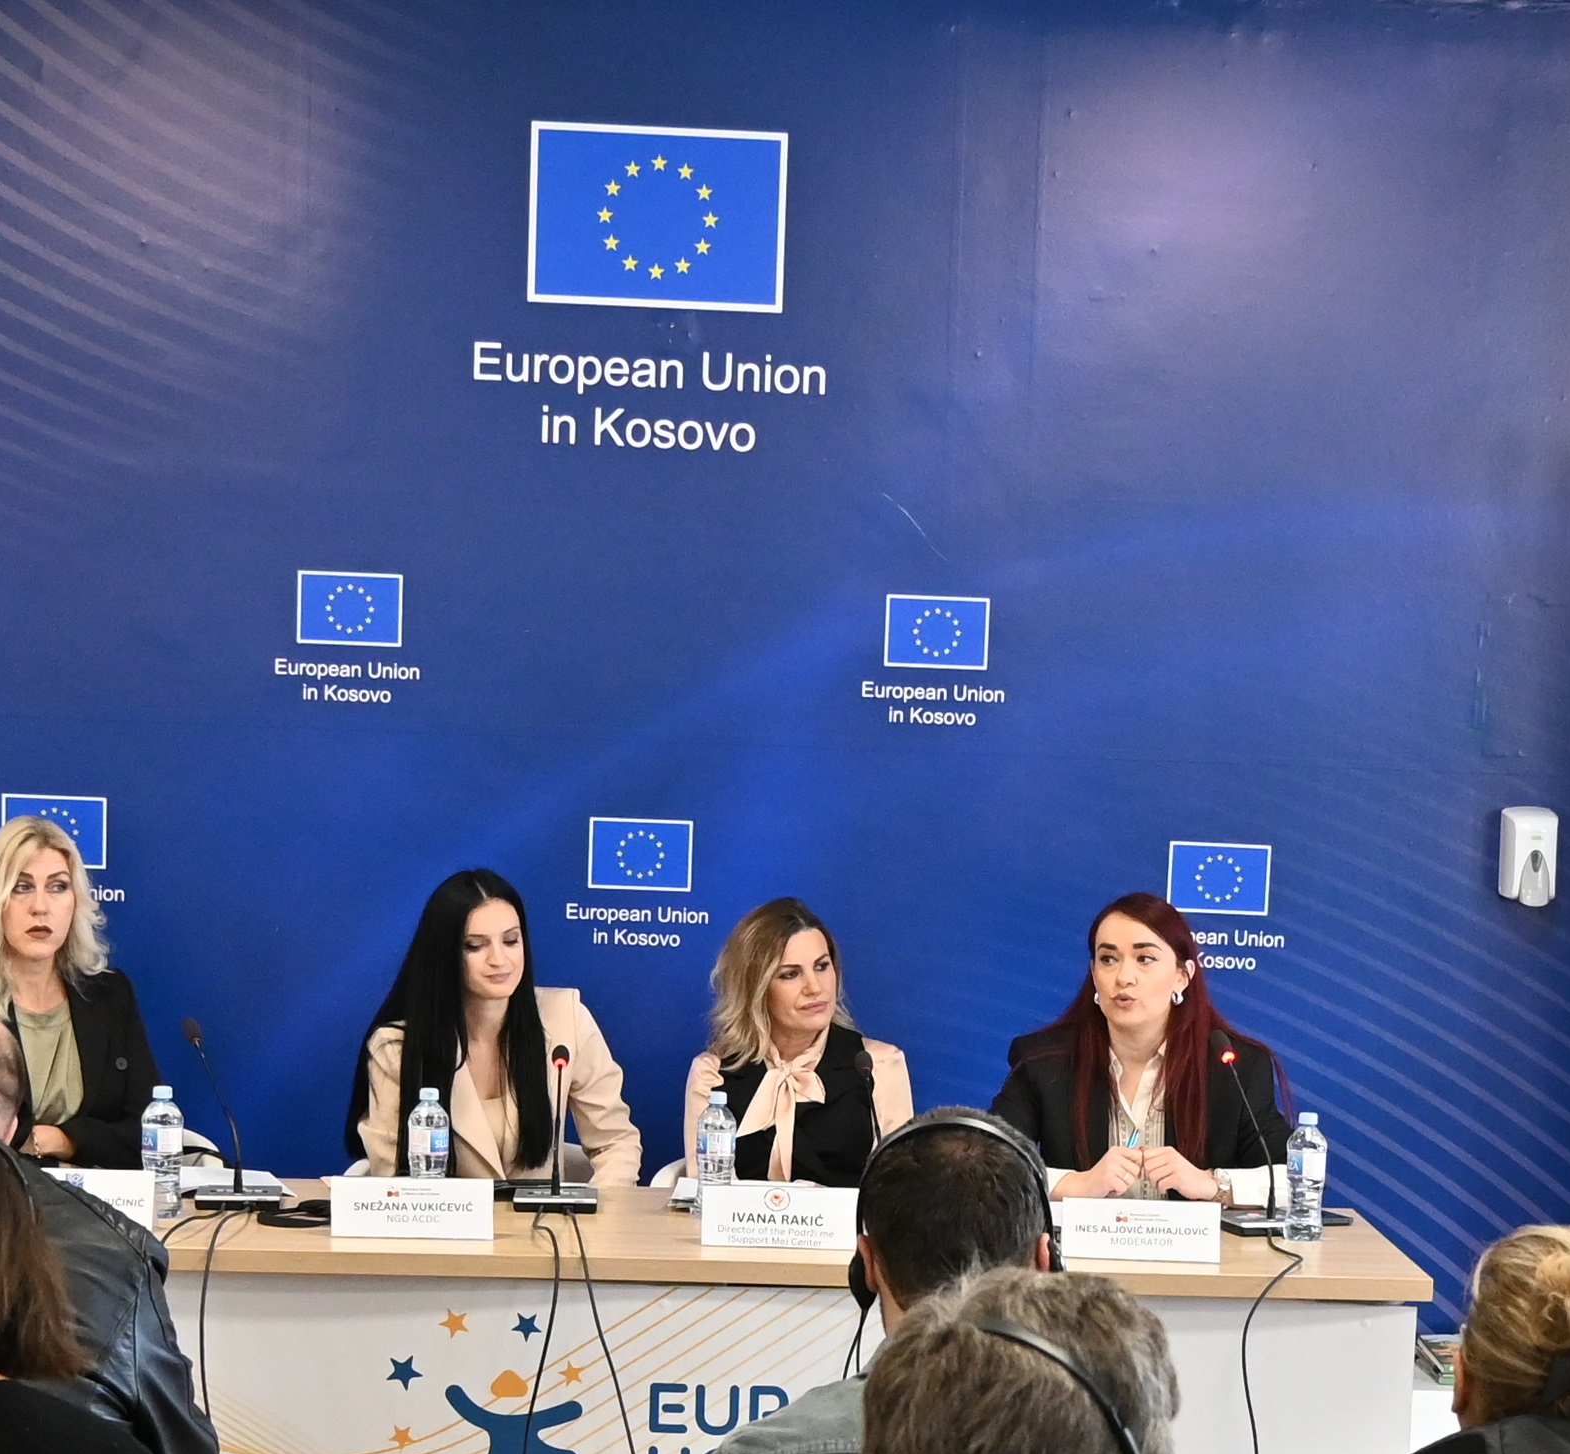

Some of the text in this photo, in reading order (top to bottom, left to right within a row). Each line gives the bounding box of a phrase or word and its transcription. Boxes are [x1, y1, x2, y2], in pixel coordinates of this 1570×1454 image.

[473, 341, 827, 396] European Union
[540, 406, 756, 452] in Kosovo
[274, 658, 421, 680] European Union
[302, 684, 392, 703] in Kosovo
[861, 681, 1006, 703] European Union
[888, 706, 976, 726] in Kosovo
[89, 884, 125, 902] nion
[565, 903, 709, 924] European Union
[593, 928, 681, 947] in Kosovo
[1234, 929, 1285, 948] Union
[353, 1200, 474, 1212] SNEŽANA VUKIĆEVIĆ
[386, 1215, 440, 1223] NGO ACDC
[732, 1212, 824, 1227] IVANA RAKIĆ
[717, 1224, 756, 1234] Director
[759, 1226, 768, 1234] of
[770, 1226, 786, 1235] the
[788, 1228, 817, 1237] Podrži
[1075, 1225, 1209, 1236] INES ALJOVIĆ MIHAJLOVIĆ
[728, 1235, 822, 1246] (Support Me) Center
[1111, 1237, 1173, 1246] MODERATOR
[649, 1382, 790, 1436] EUR
